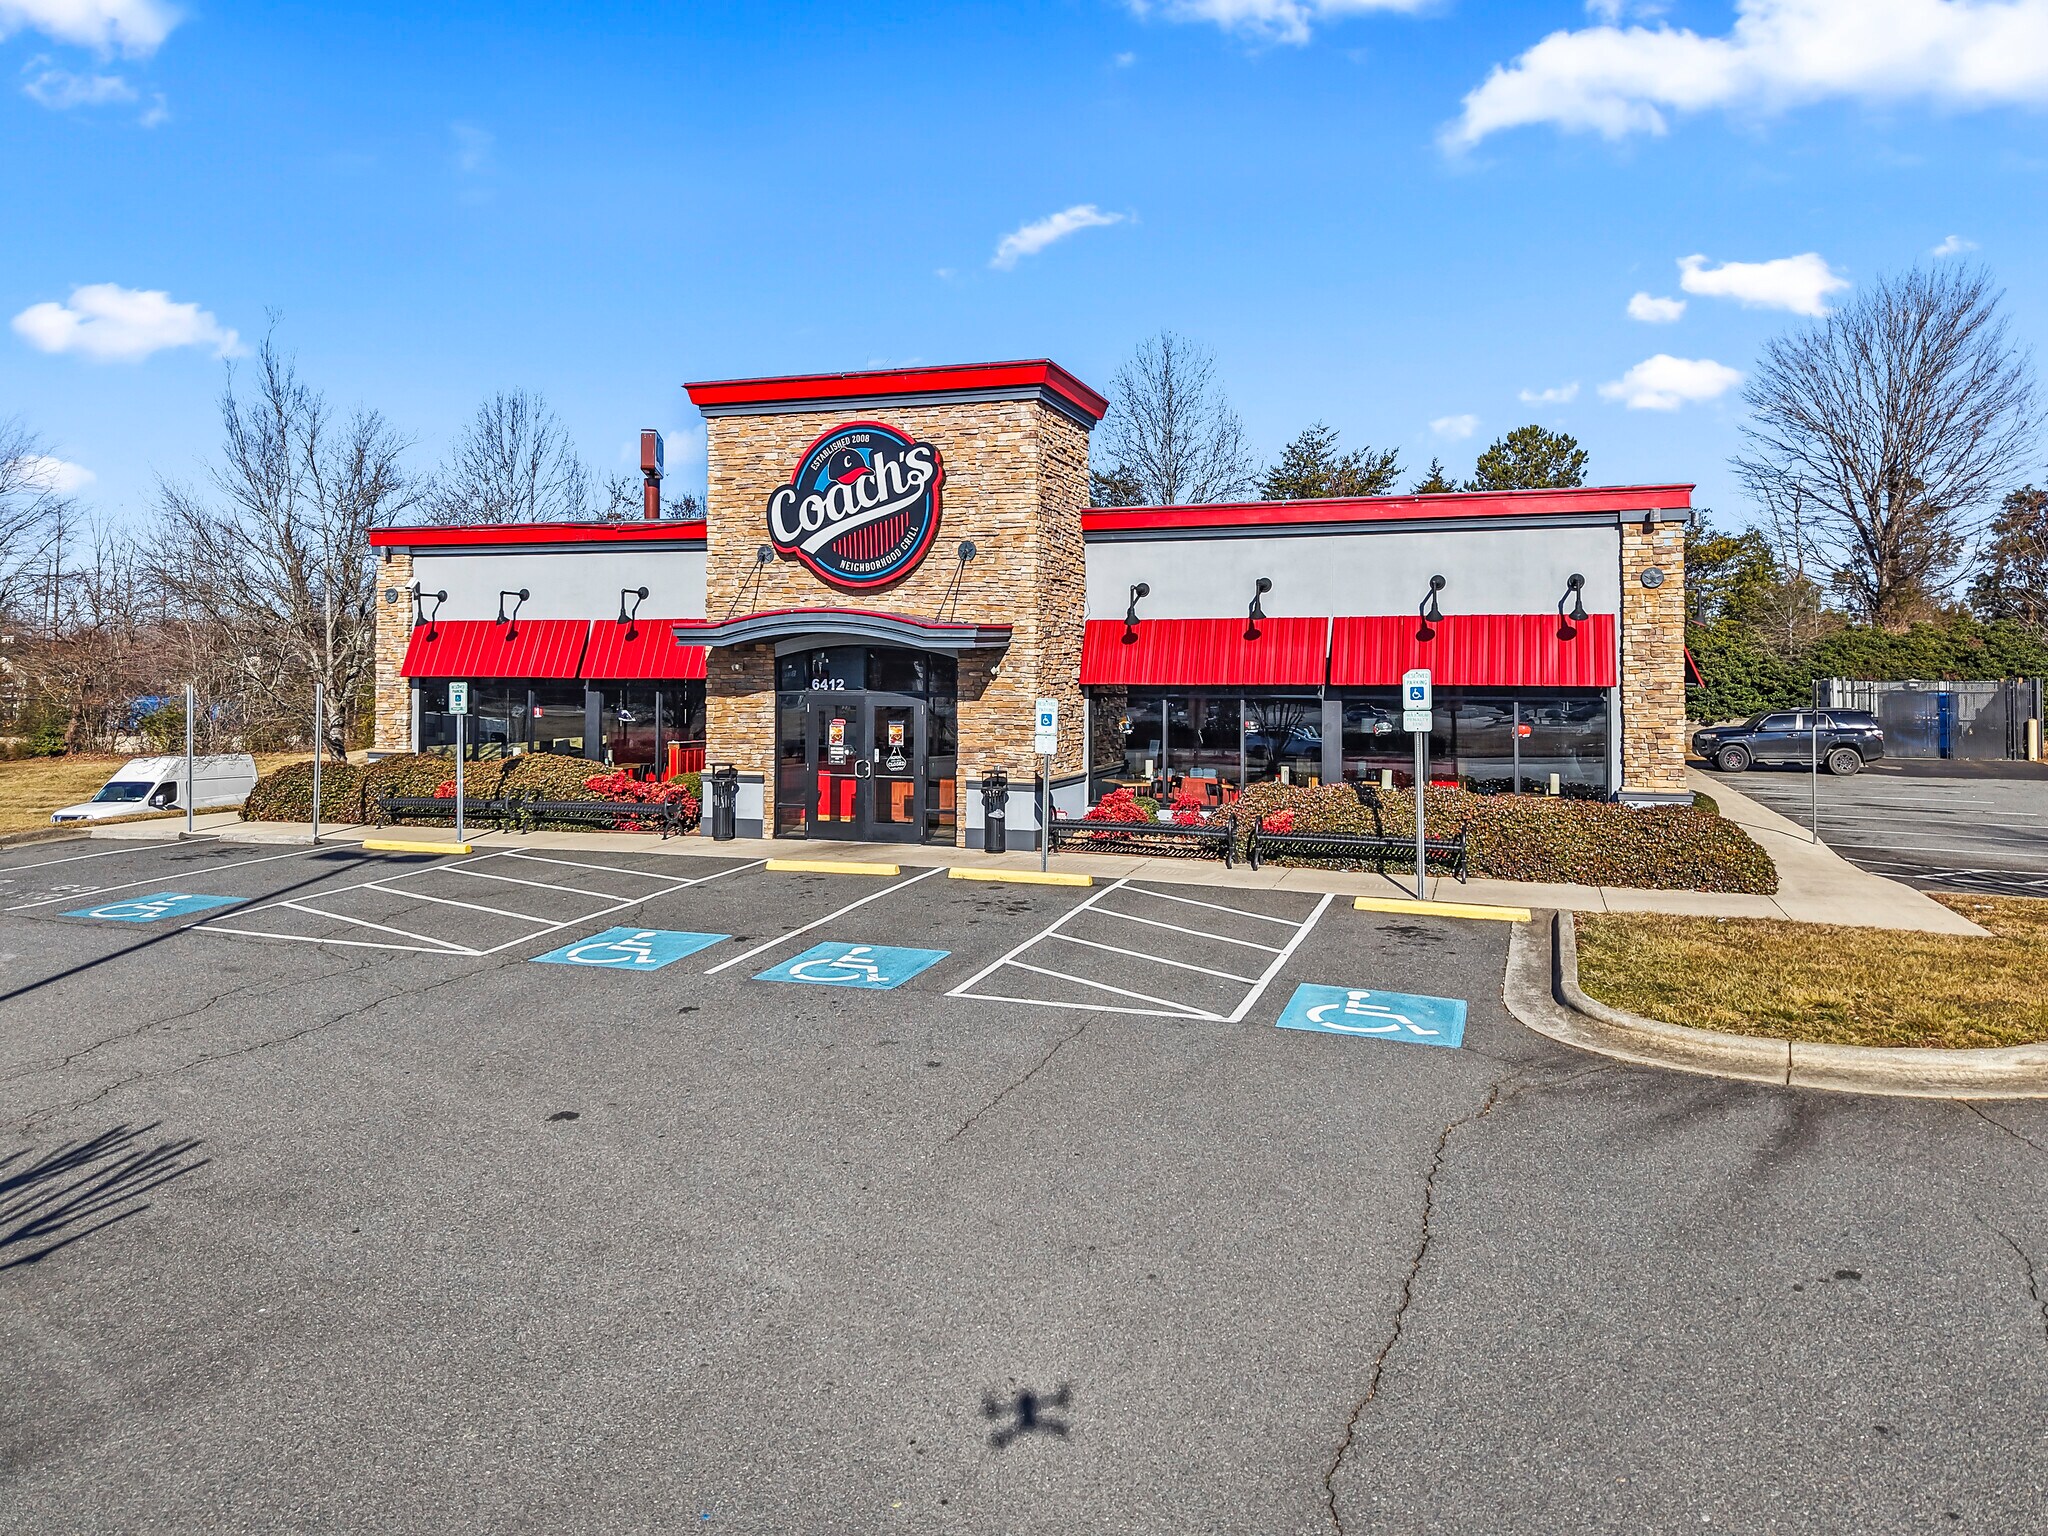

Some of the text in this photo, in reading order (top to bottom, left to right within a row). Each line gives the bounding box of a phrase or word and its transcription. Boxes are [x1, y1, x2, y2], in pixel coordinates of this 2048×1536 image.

[810, 434, 870, 471] ESTABLISHED 2008
[843, 455, 852, 468] C
[771, 447, 933, 542] Coach's
[839, 526, 919, 572] NEIGHBORHOOD GRILL
[812, 678, 845, 691] 6412
